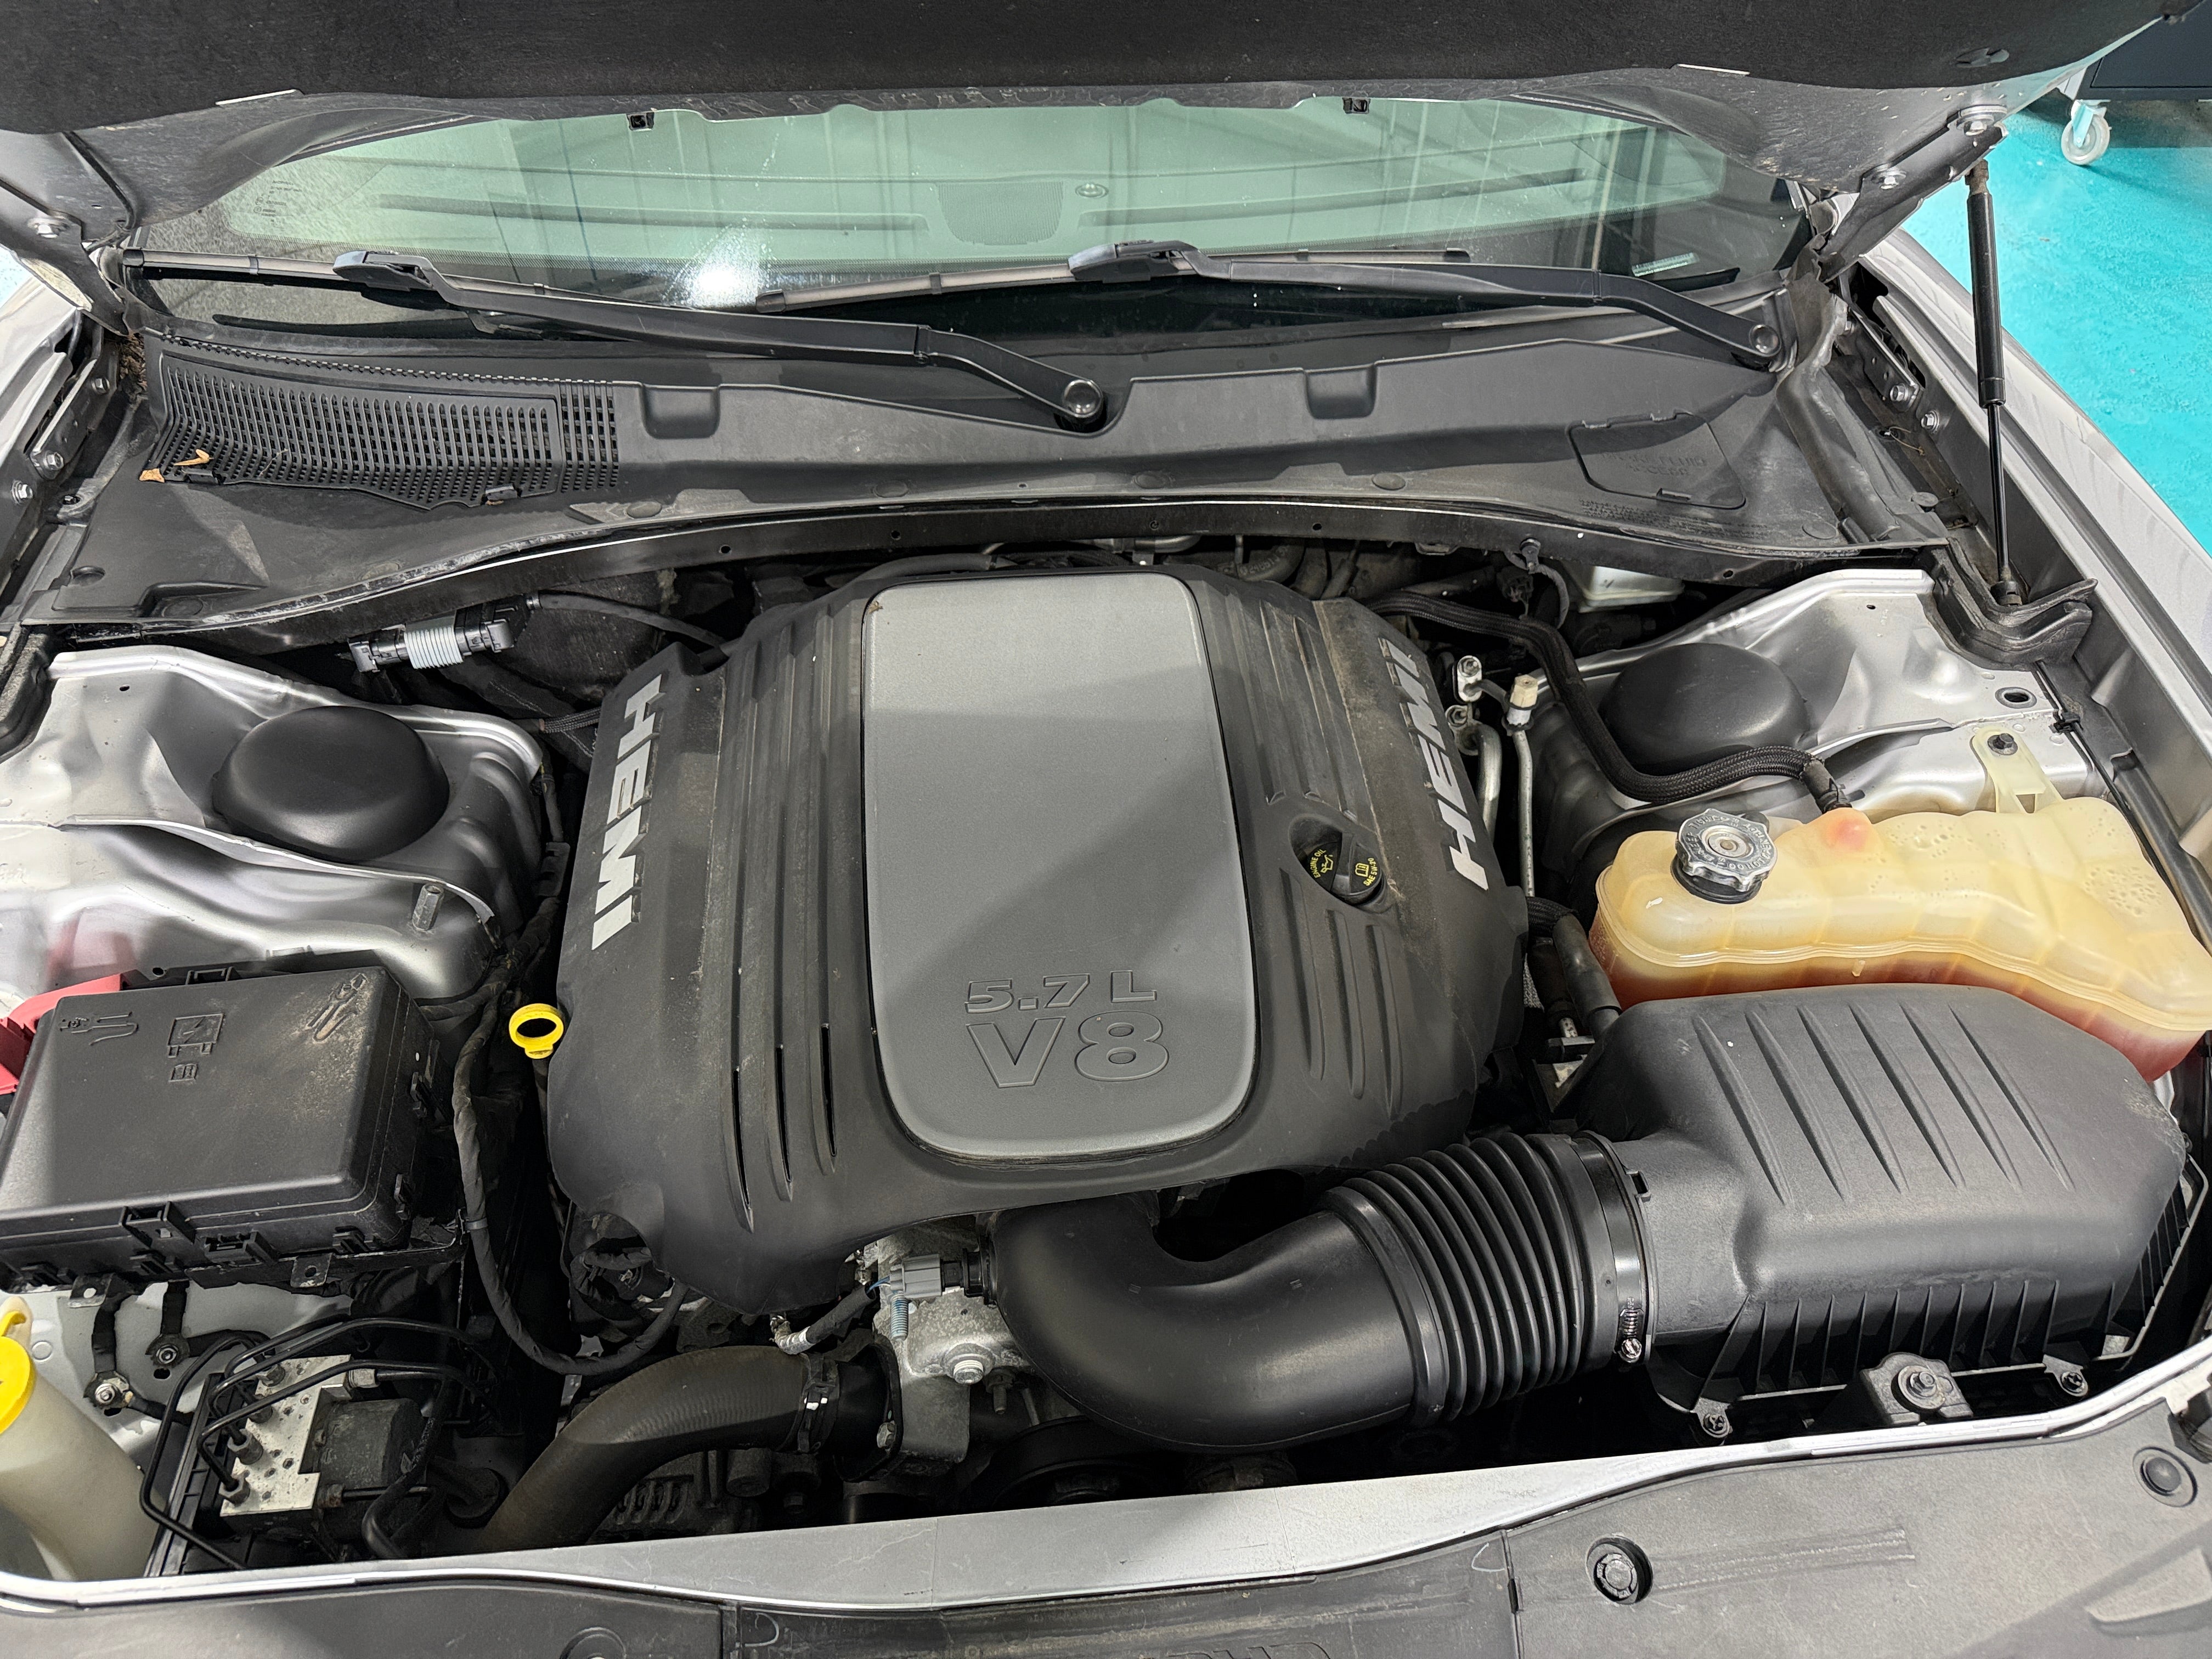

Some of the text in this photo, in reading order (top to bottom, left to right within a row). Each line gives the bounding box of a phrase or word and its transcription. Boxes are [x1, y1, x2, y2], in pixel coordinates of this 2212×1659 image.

[1385, 637, 1488, 890] HEMI
[592, 674, 662, 950] HEMI
[1310, 849, 1327, 879] ENGINE OIL
[1363, 857, 1378, 886] SAE 5W-20
[965, 1009, 1170, 1088] V8
